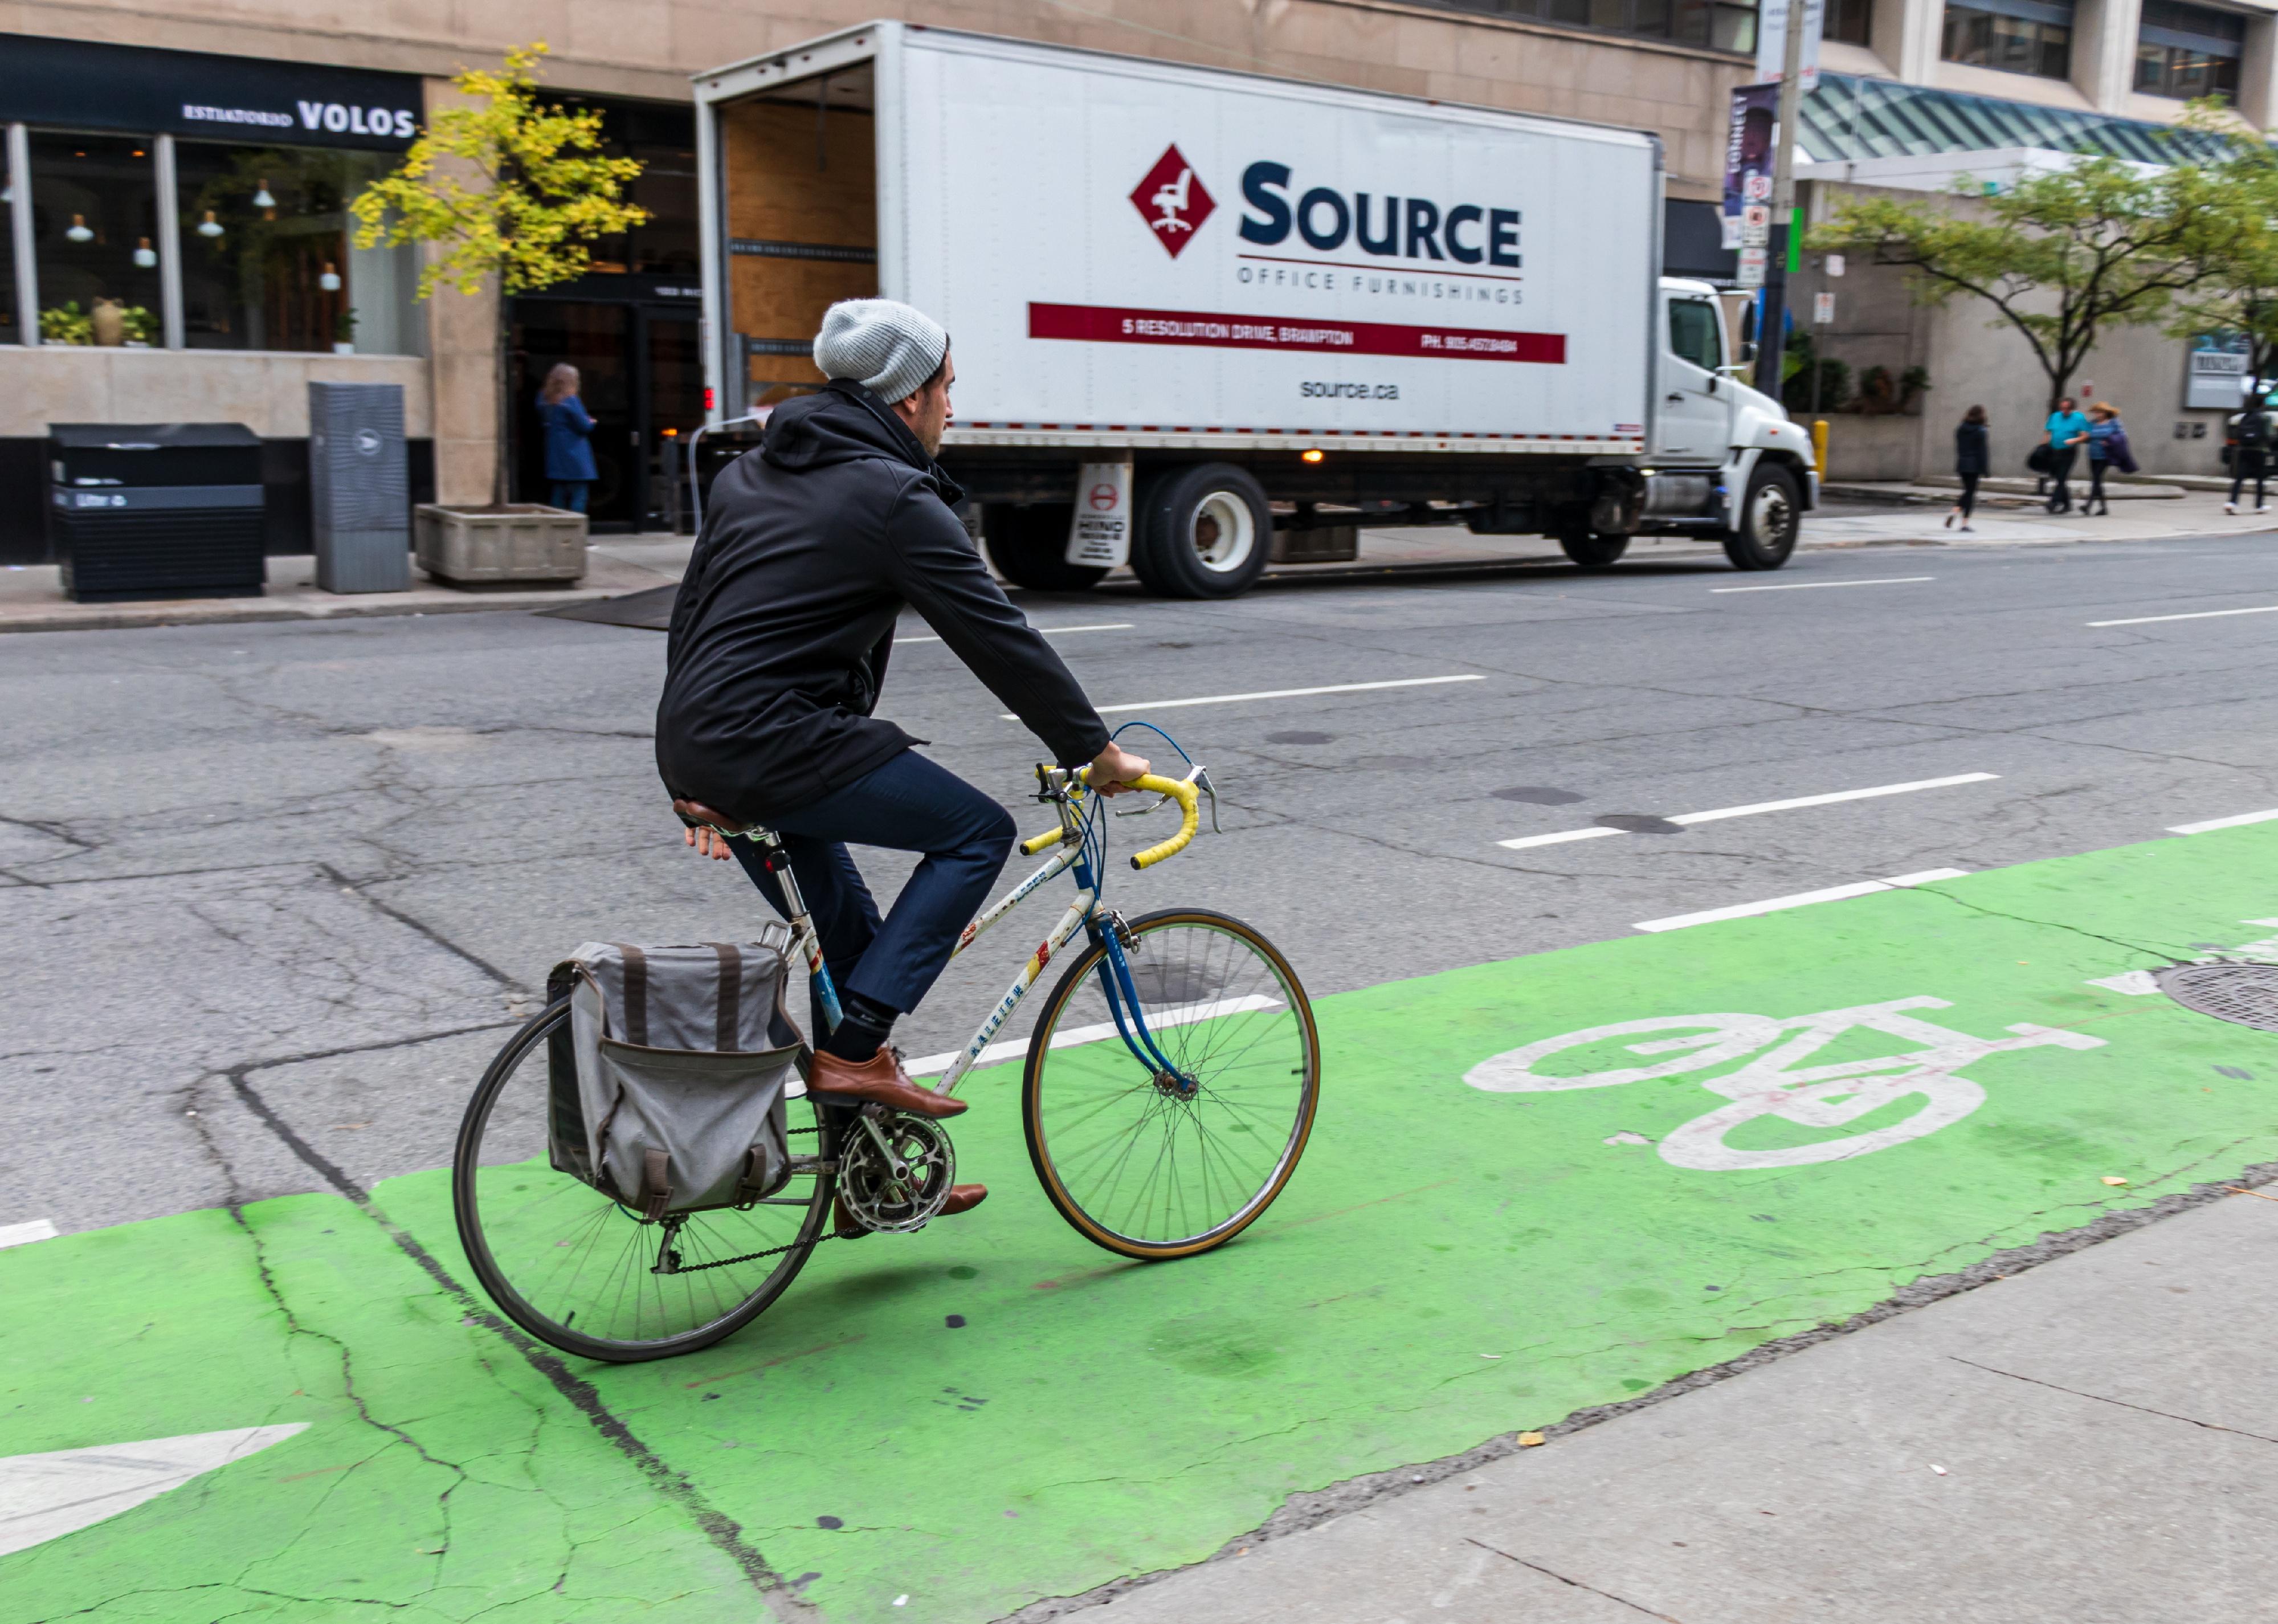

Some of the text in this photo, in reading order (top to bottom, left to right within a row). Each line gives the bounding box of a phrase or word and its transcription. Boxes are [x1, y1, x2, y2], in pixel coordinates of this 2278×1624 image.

[297, 100, 415, 138] VOLOS
[1237, 160, 1522, 268] SOURCE
[1238, 267, 1523, 305] OFFICE FURNISHINGS
[1121, 319, 1354, 345] 5 RESOLUTION DRIVE, BRAMPTON
[1300, 381, 1400, 399] source.ca
[1079, 521, 1125, 532] HINO
